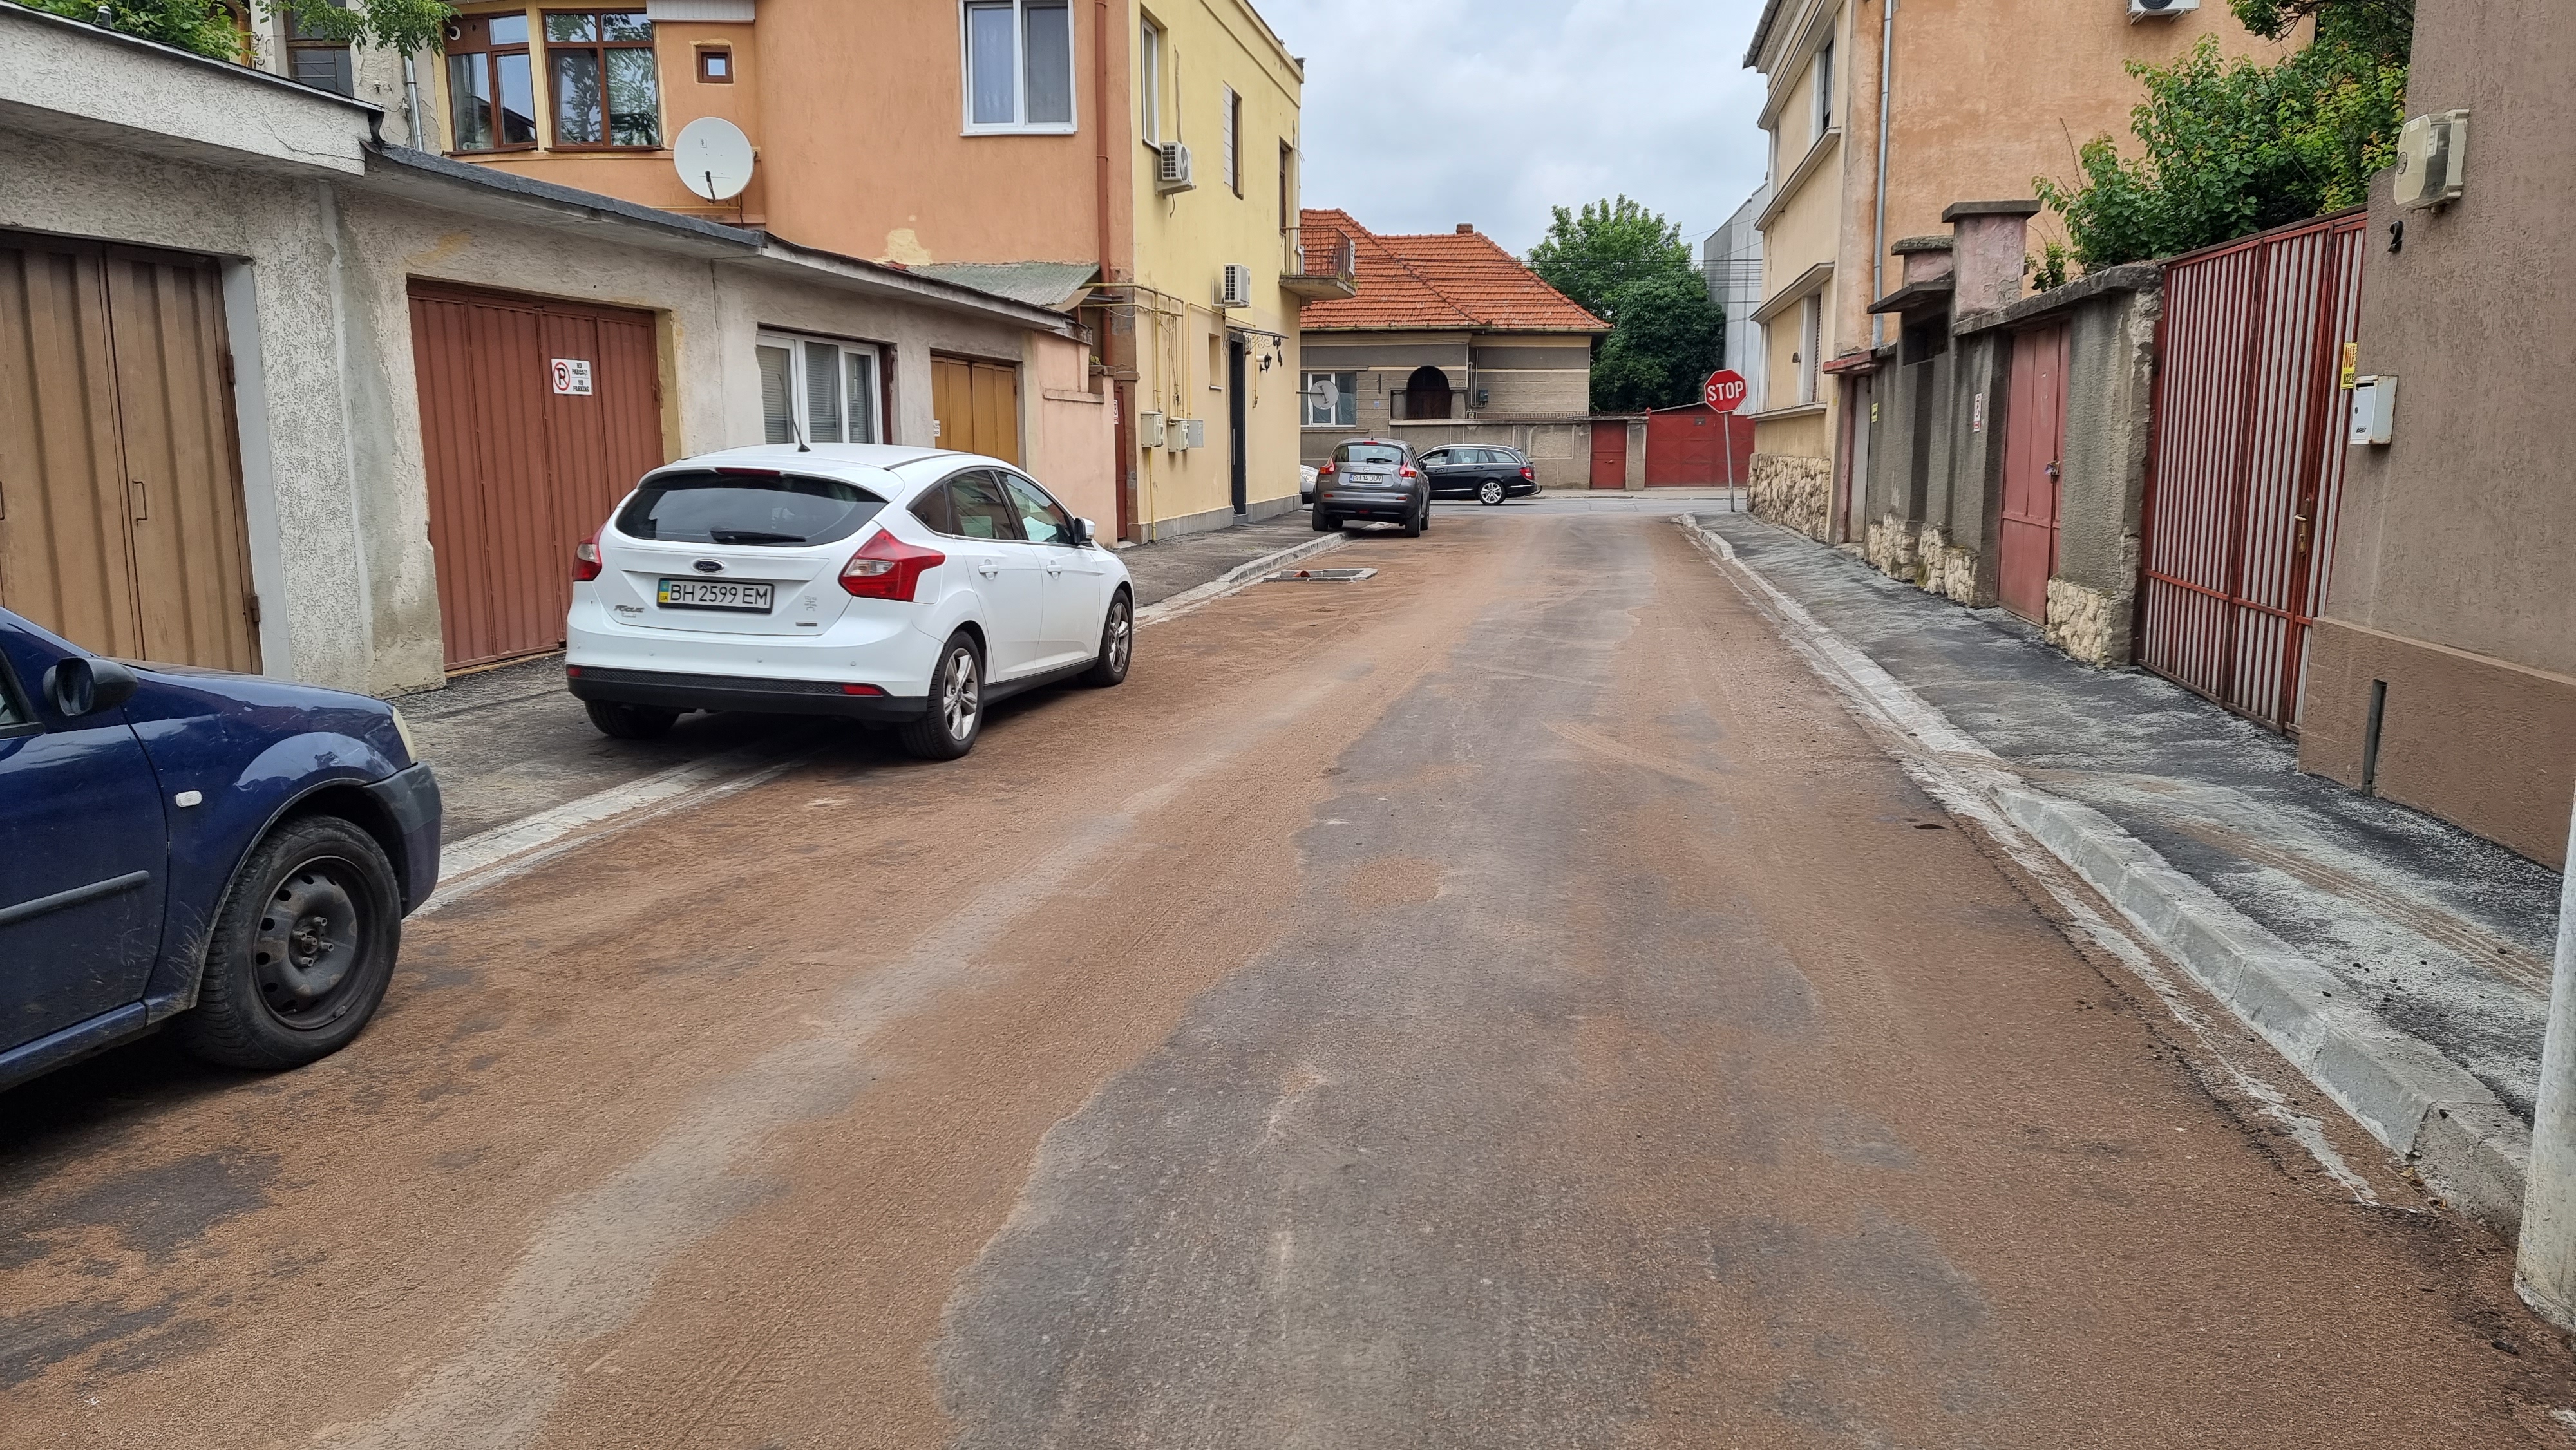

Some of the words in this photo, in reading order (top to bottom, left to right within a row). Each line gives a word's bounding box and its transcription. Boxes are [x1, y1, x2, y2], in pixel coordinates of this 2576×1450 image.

[1707, 381, 1743, 401] STOP
[670, 584, 695, 601] BH
[699, 585, 737, 603] 2599
[742, 587, 768, 605] EM
